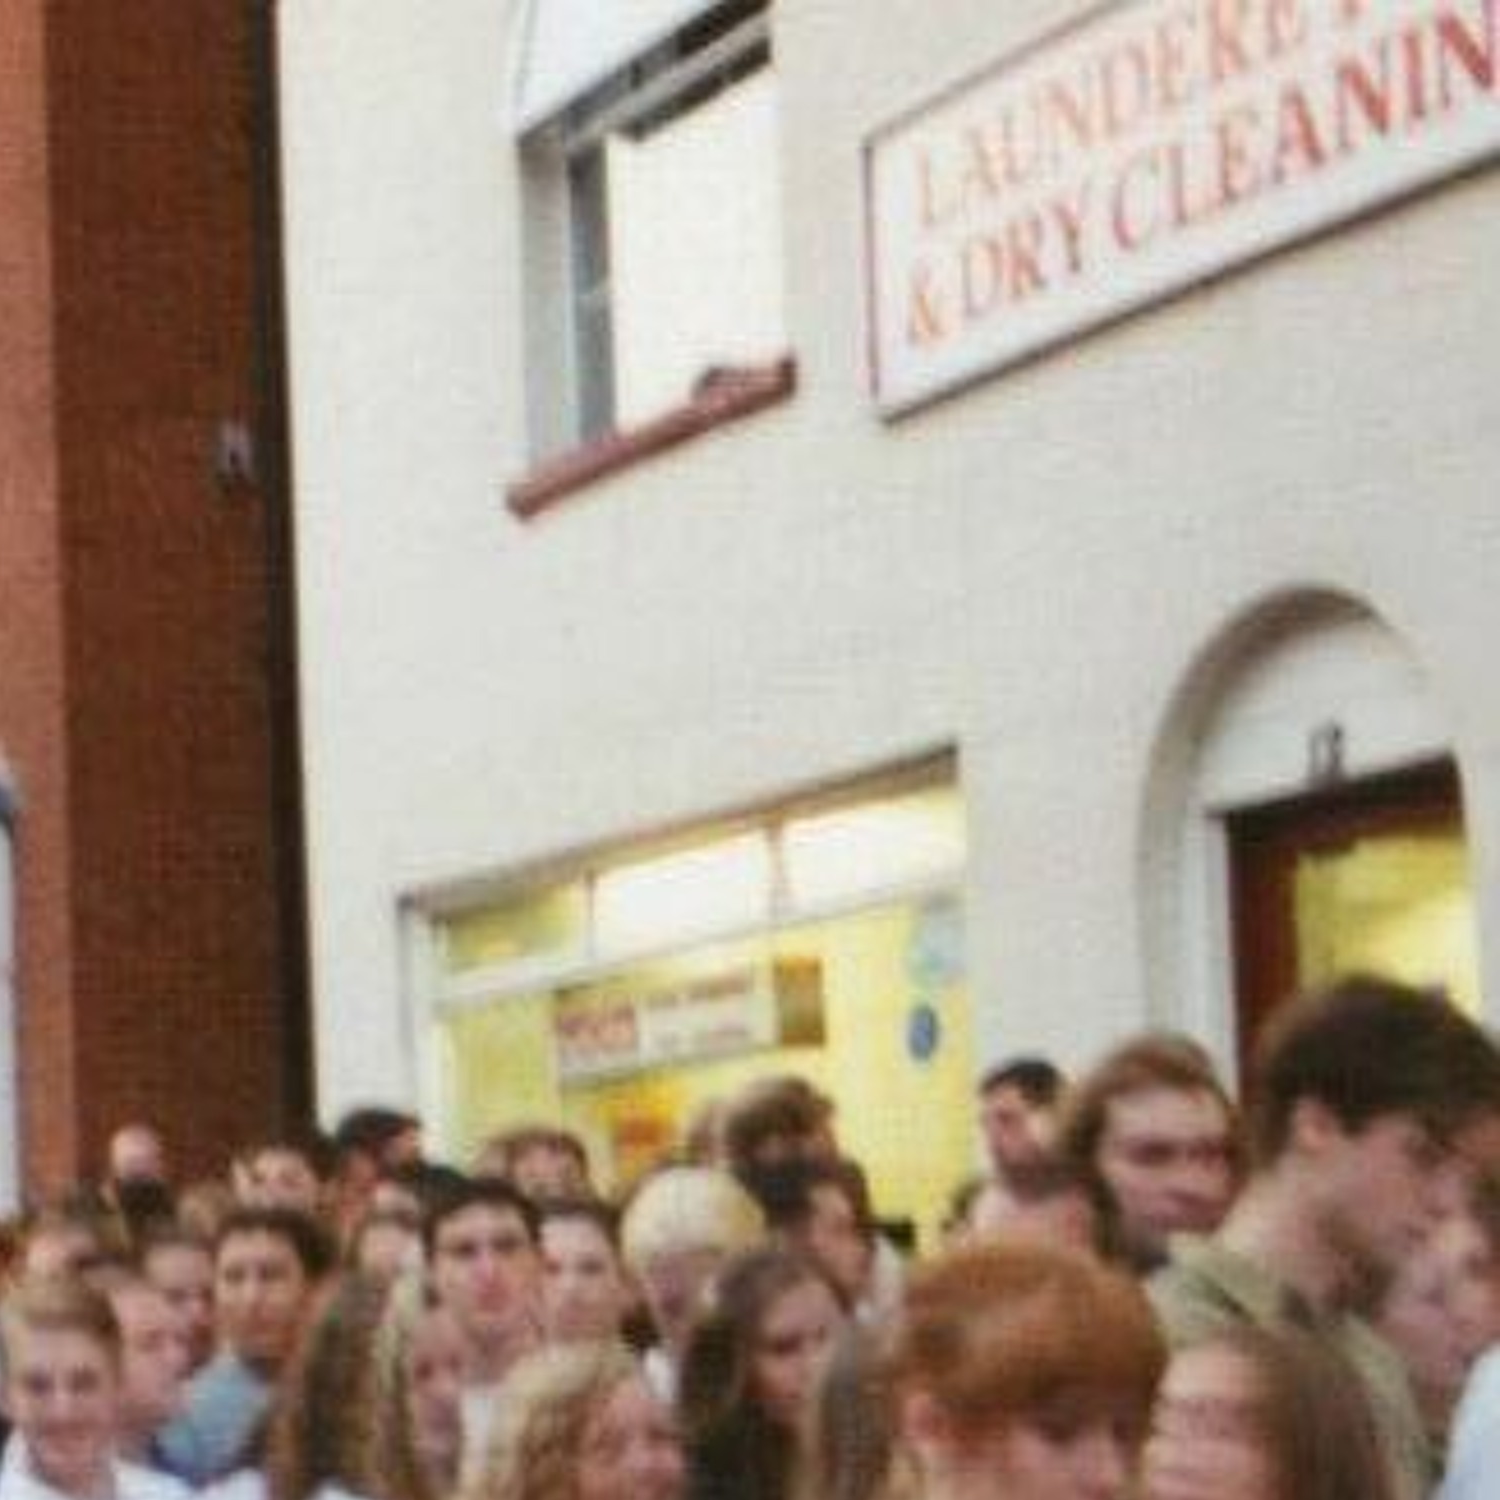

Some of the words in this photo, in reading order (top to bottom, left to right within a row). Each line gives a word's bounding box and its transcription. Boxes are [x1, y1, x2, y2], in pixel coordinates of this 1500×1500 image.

[914, 0, 1366, 226] LAUNDERE
[906, 258, 946, 346] &
[961, 180, 1092, 318] DRY
